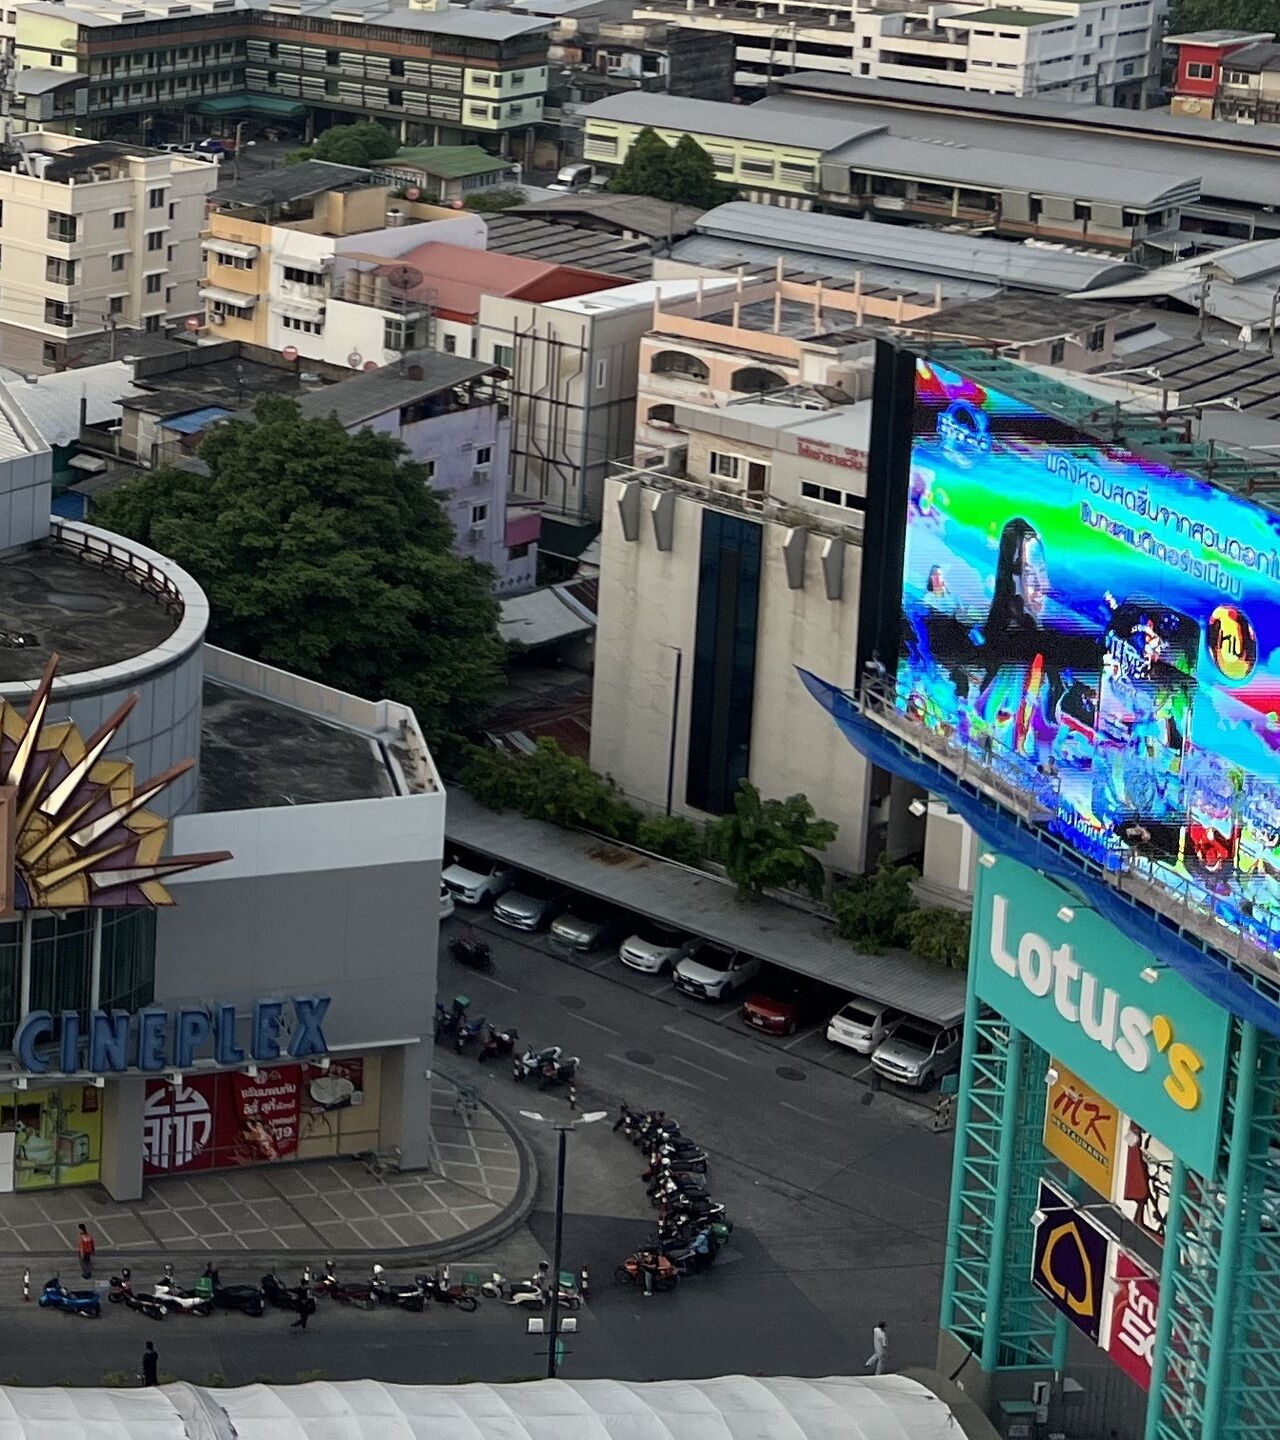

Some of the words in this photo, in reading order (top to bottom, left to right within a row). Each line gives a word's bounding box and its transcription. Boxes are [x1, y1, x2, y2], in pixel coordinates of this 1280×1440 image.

[12, 993, 333, 1074] CINEPLEX
[990, 893, 1203, 1111] Lotus's
[1051, 1113, 1109, 1169] RESTAURANTS
[1053, 1084, 1112, 1152] MK
